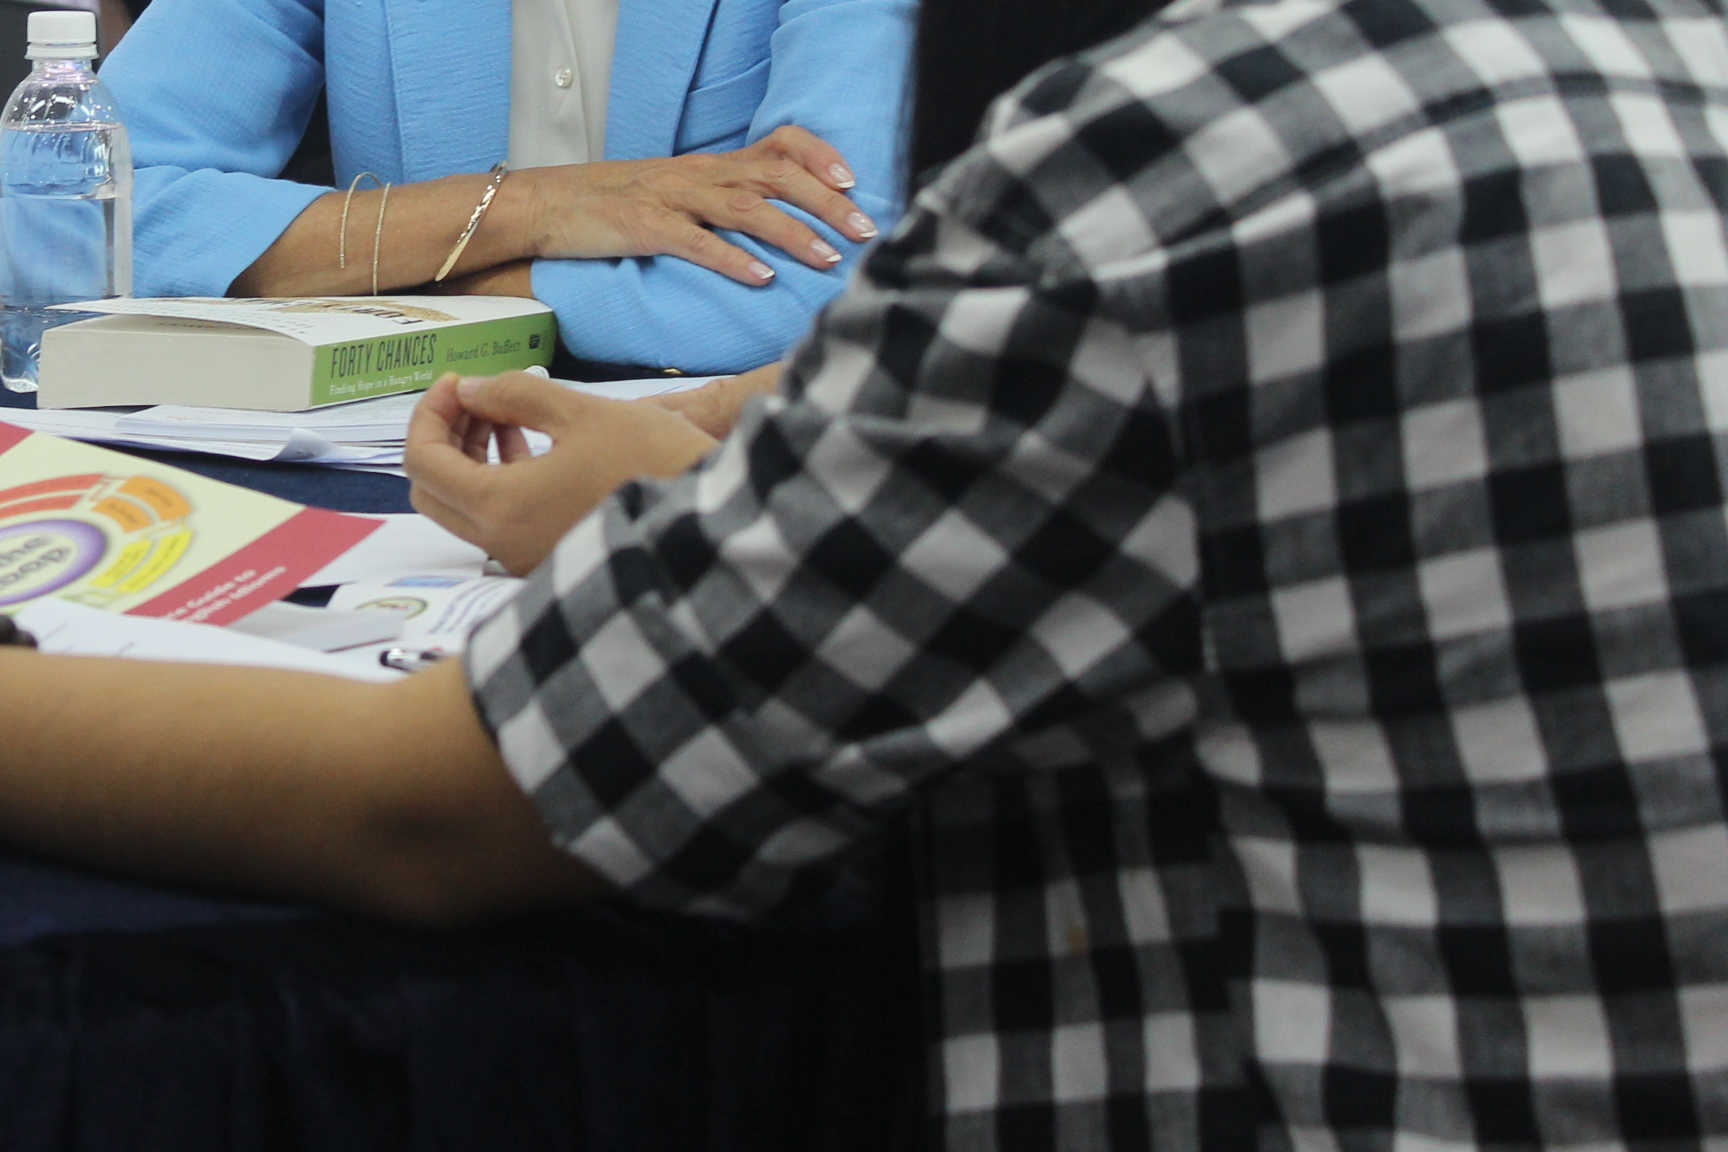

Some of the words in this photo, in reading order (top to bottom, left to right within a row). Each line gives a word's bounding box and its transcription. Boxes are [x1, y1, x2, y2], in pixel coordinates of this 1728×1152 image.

[331, 342, 373, 379] FORTY
[377, 333, 437, 371] CHANCES
[446, 344, 479, 363] Howard
[329, 381, 356, 396] Finding
[357, 379, 374, 393] Hope
[389, 373, 413, 388] Hungry
[414, 368, 433, 383] World
